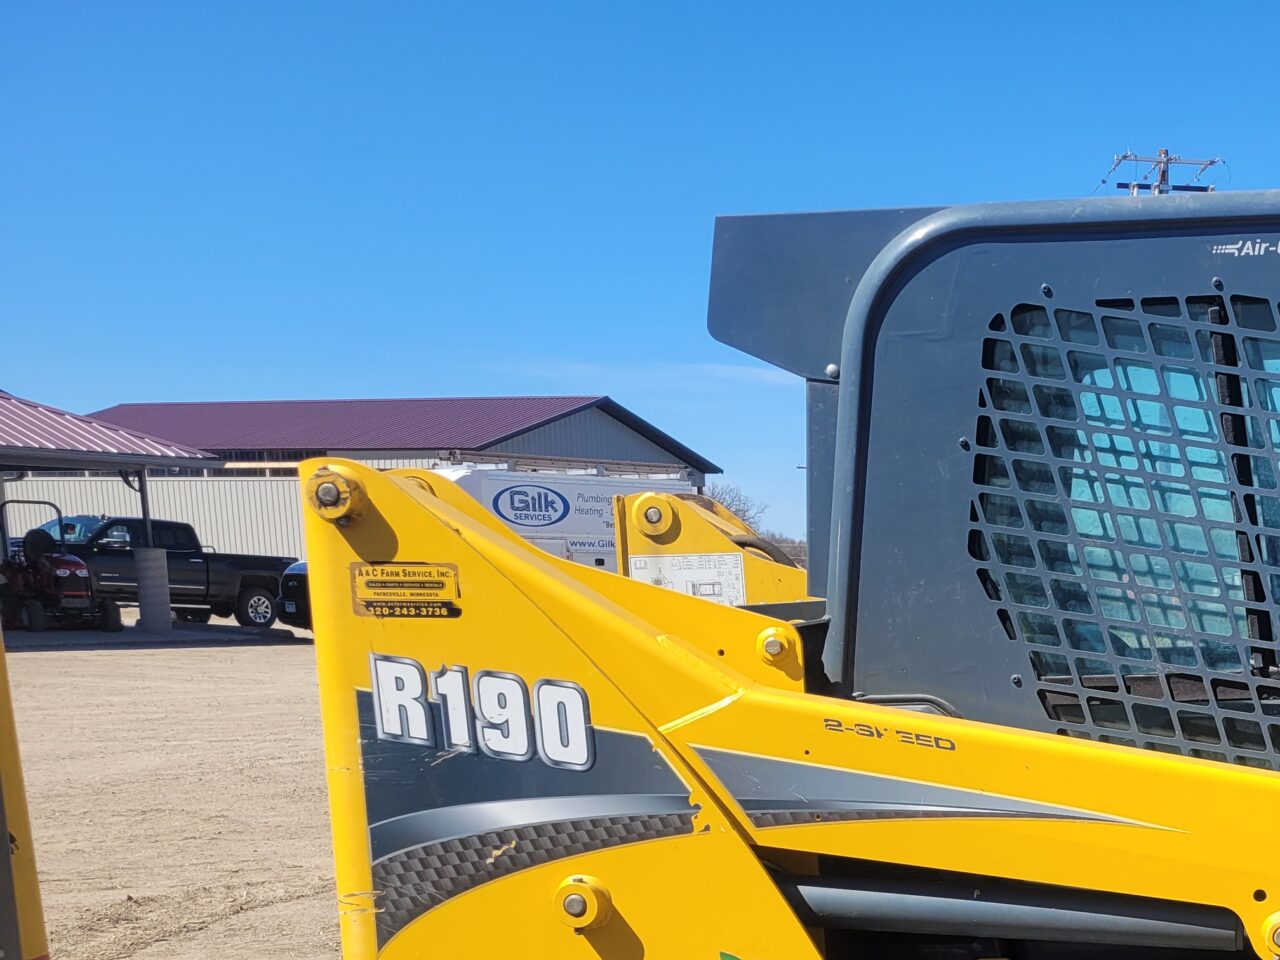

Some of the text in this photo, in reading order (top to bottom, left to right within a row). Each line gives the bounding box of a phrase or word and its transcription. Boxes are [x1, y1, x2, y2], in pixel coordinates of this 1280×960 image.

[509, 489, 558, 513] Gilk
[576, 493, 612, 505] Plumbing
[513, 512, 552, 521] SERVICES
[574, 506, 603, 517] Heating
[358, 569, 364, 577] A
[372, 569, 378, 577] C
[368, 607, 448, 615] 320-243-3736
[369, 653, 596, 772] R190
